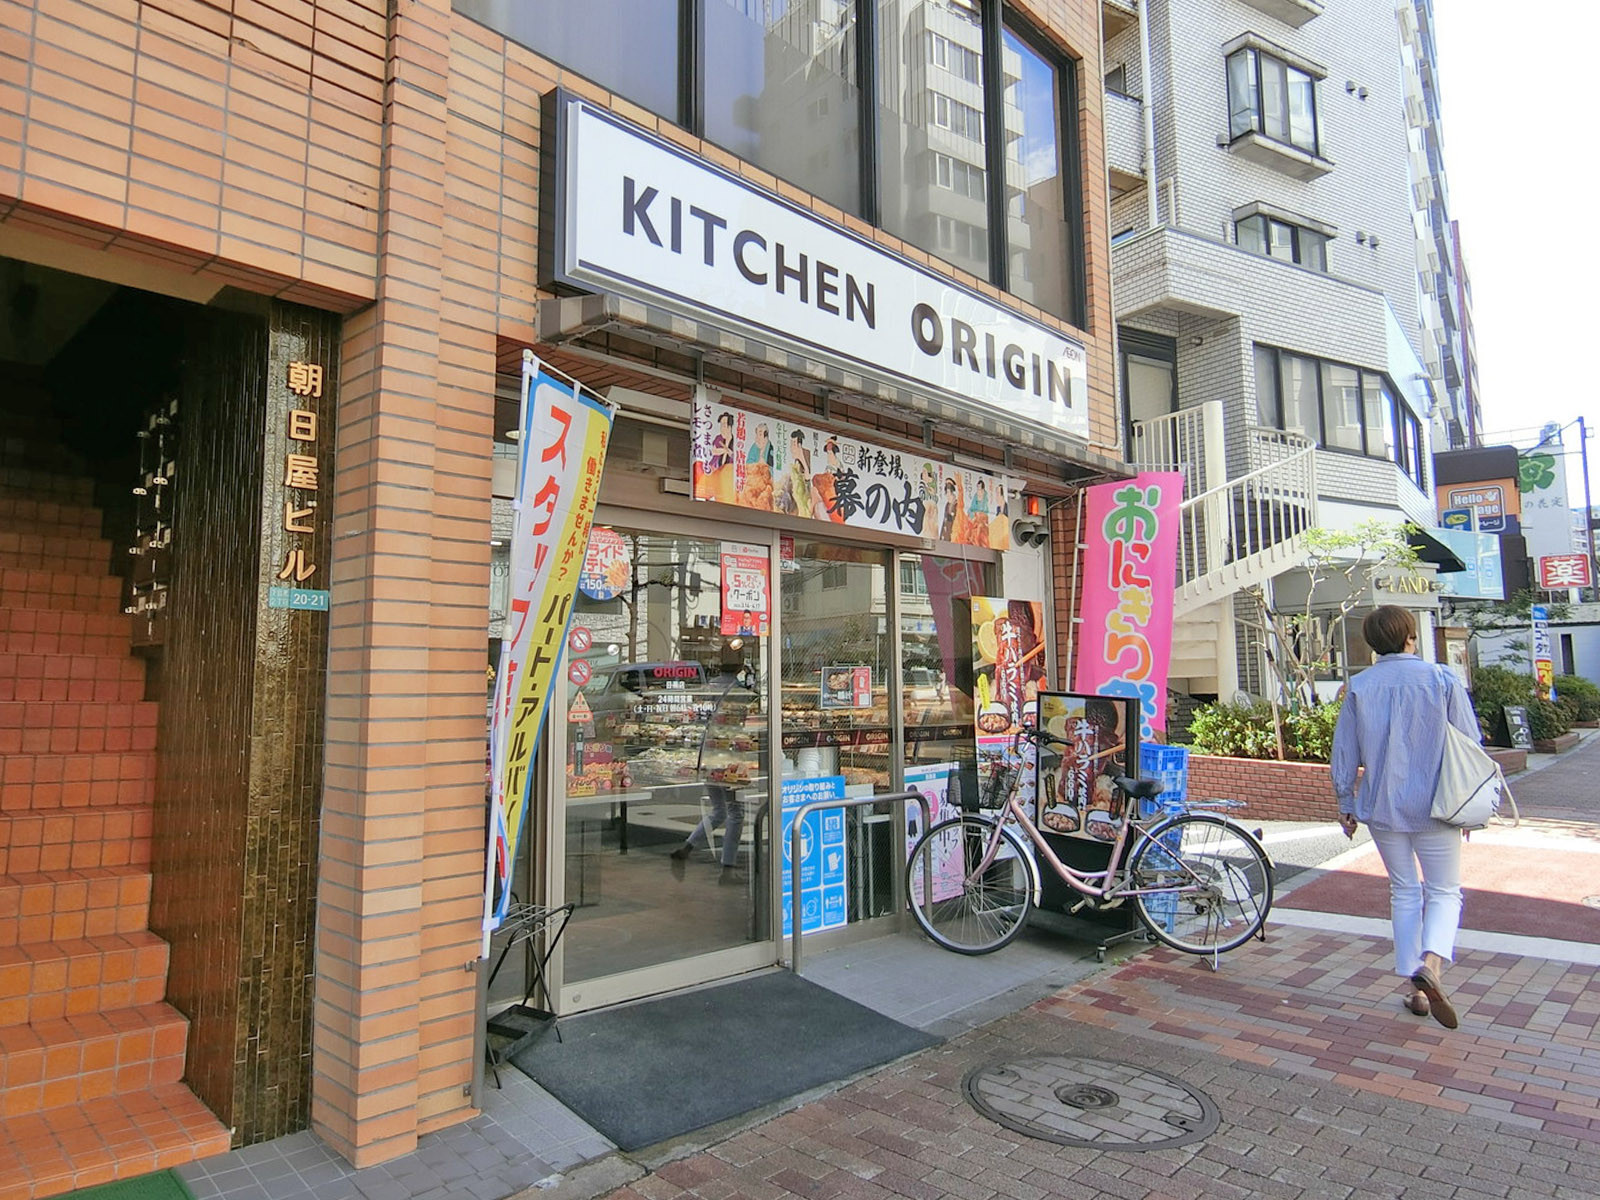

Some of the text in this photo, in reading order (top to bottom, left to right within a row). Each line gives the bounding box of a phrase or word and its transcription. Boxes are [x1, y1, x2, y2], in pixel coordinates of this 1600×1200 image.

[623, 175, 1073, 409] KITCHEN ORIGIN
[702, 404, 713, 475] さつまいも
[279, 361, 323, 581] 朝日屋ビル
[827, 468, 926, 535] 幕の内
[1454, 493, 1483, 505] Hello
[1545, 559, 1585, 585] 薬
[585, 578, 602, 590] 150
[293, 594, 324, 606] 20-21
[733, 589, 760, 601] クーポン
[653, 666, 698, 678] ORIGIN
[866, 731, 889, 742] ORIGIN
[782, 782, 835, 794] オリジンの取り組みと
